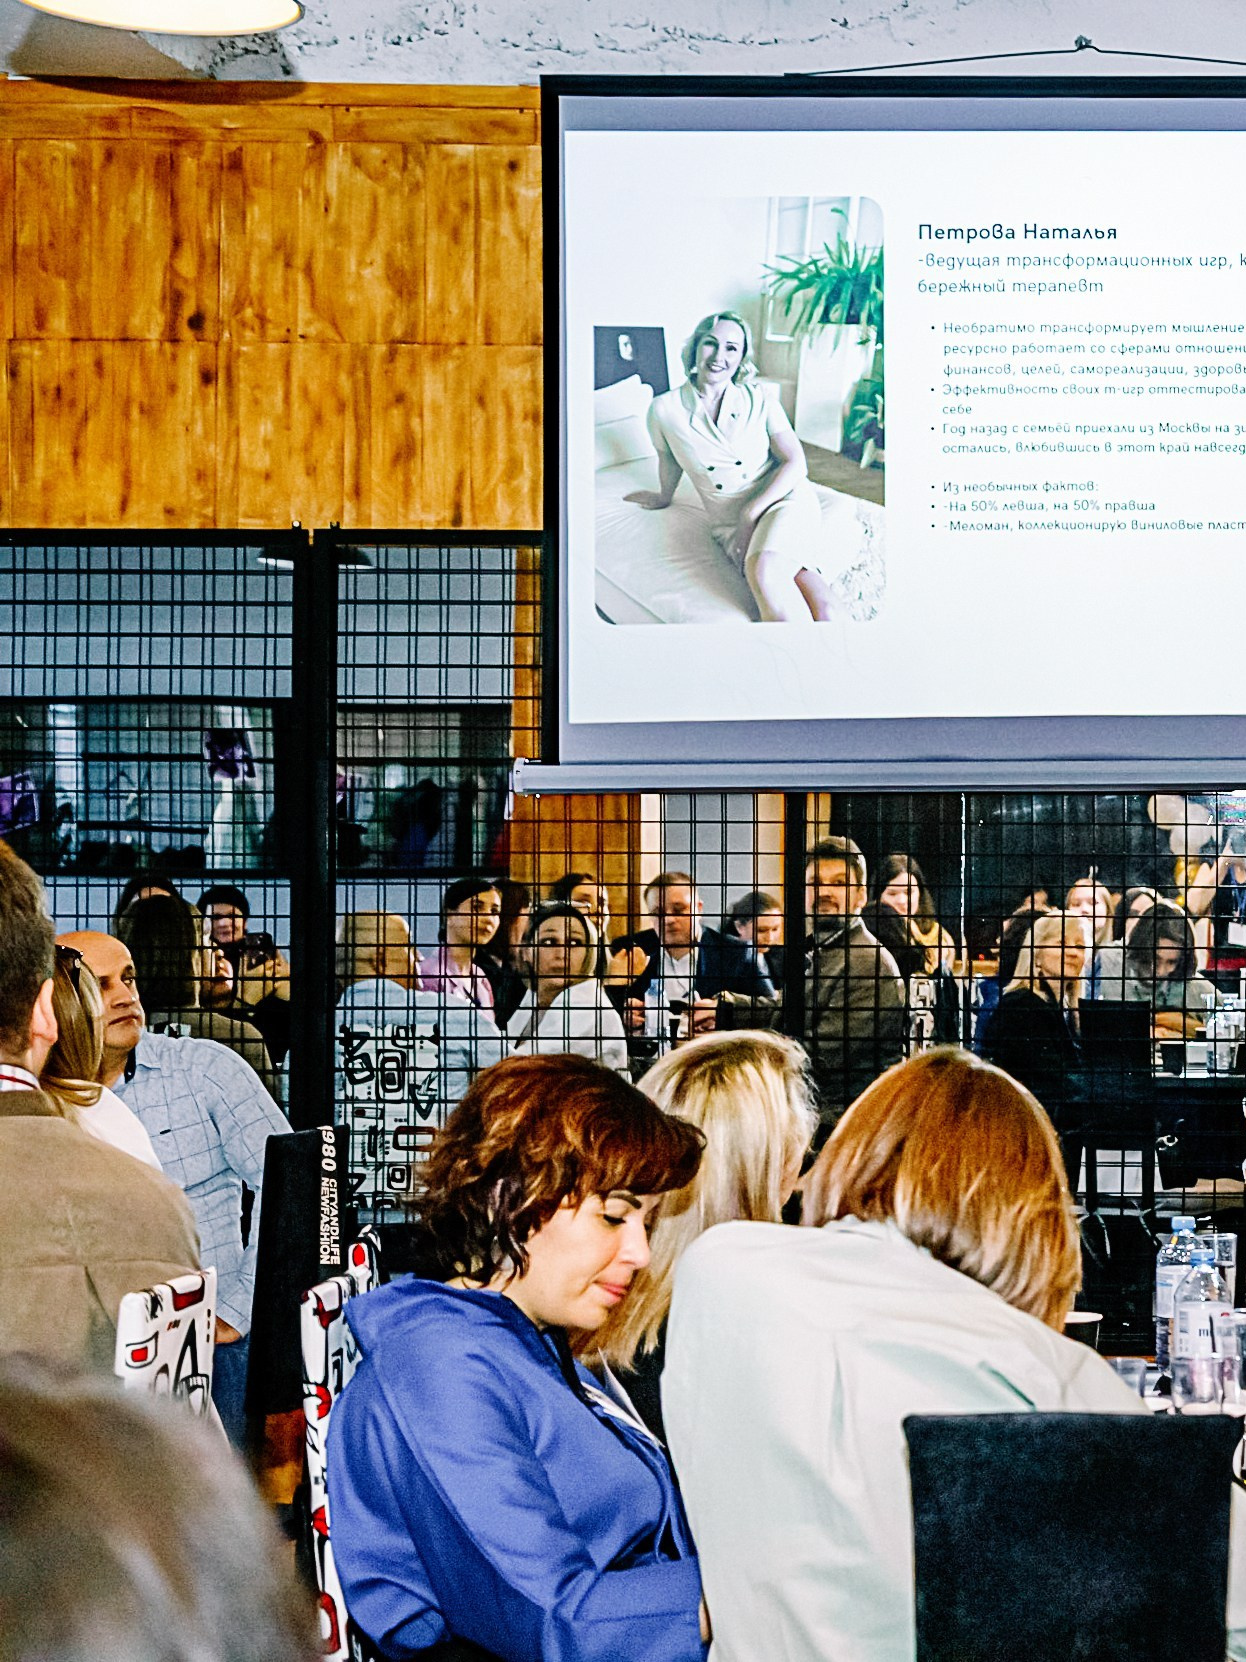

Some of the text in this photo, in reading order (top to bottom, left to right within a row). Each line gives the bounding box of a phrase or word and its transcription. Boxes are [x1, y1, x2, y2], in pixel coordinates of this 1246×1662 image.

[918, 222, 1118, 245] Петрова Наталья
[1006, 252, 1193, 270] трансформационных
[1199, 255, 1233, 271] игр,
[917, 277, 1104, 297] бережный терапевт
[943, 321, 1036, 336] Необратимо
[1039, 321, 1167, 336] трансформирует
[1171, 323, 1245, 334] мышление
[943, 344, 1008, 357] ресурсно
[1011, 342, 1086, 357] работает
[1089, 344, 1106, 355] со
[1110, 341, 1171, 357] сферами
[943, 363, 1016, 379] финансов,
[1021, 363, 1065, 377] целей,
[1069, 365, 1188, 378] самореализации,
[942, 383, 1059, 398] Эффективность
[1062, 383, 1100, 396] своих
[1103, 385, 1145, 397] т-игр
[941, 403, 973, 415] себе
[942, 422, 967, 438] Год
[970, 424, 1008, 437] назад
[1011, 424, 1019, 434] с
[1075, 424, 1135, 436] приехали
[1139, 424, 1155, 437] из
[1158, 421, 1211, 434] Москвы
[1214, 424, 1231, 433] на
[941, 444, 1011, 455] остались,
[1015, 441, 1101, 453] влюбившись
[1104, 441, 1113, 453] в
[1116, 443, 1156, 454] этот
[1159, 441, 1191, 455] край
[943, 480, 1099, 496] Из необычных фактов:
[970, 499, 999, 512] 50%
[1002, 499, 1049, 513] левша,
[1053, 502, 1069, 511] на
[1073, 498, 1101, 512] 50%
[1104, 499, 1157, 514] правша
[943, 519, 1014, 533] -Меломан,
[1018, 519, 1127, 533] коллекционирую
[1130, 518, 1204, 531] виниловые
[316, 1125, 337, 1172] 1980
[320, 1176, 331, 1265] NEWFASHION
[329, 1178, 341, 1265] CITYANDLIFE
